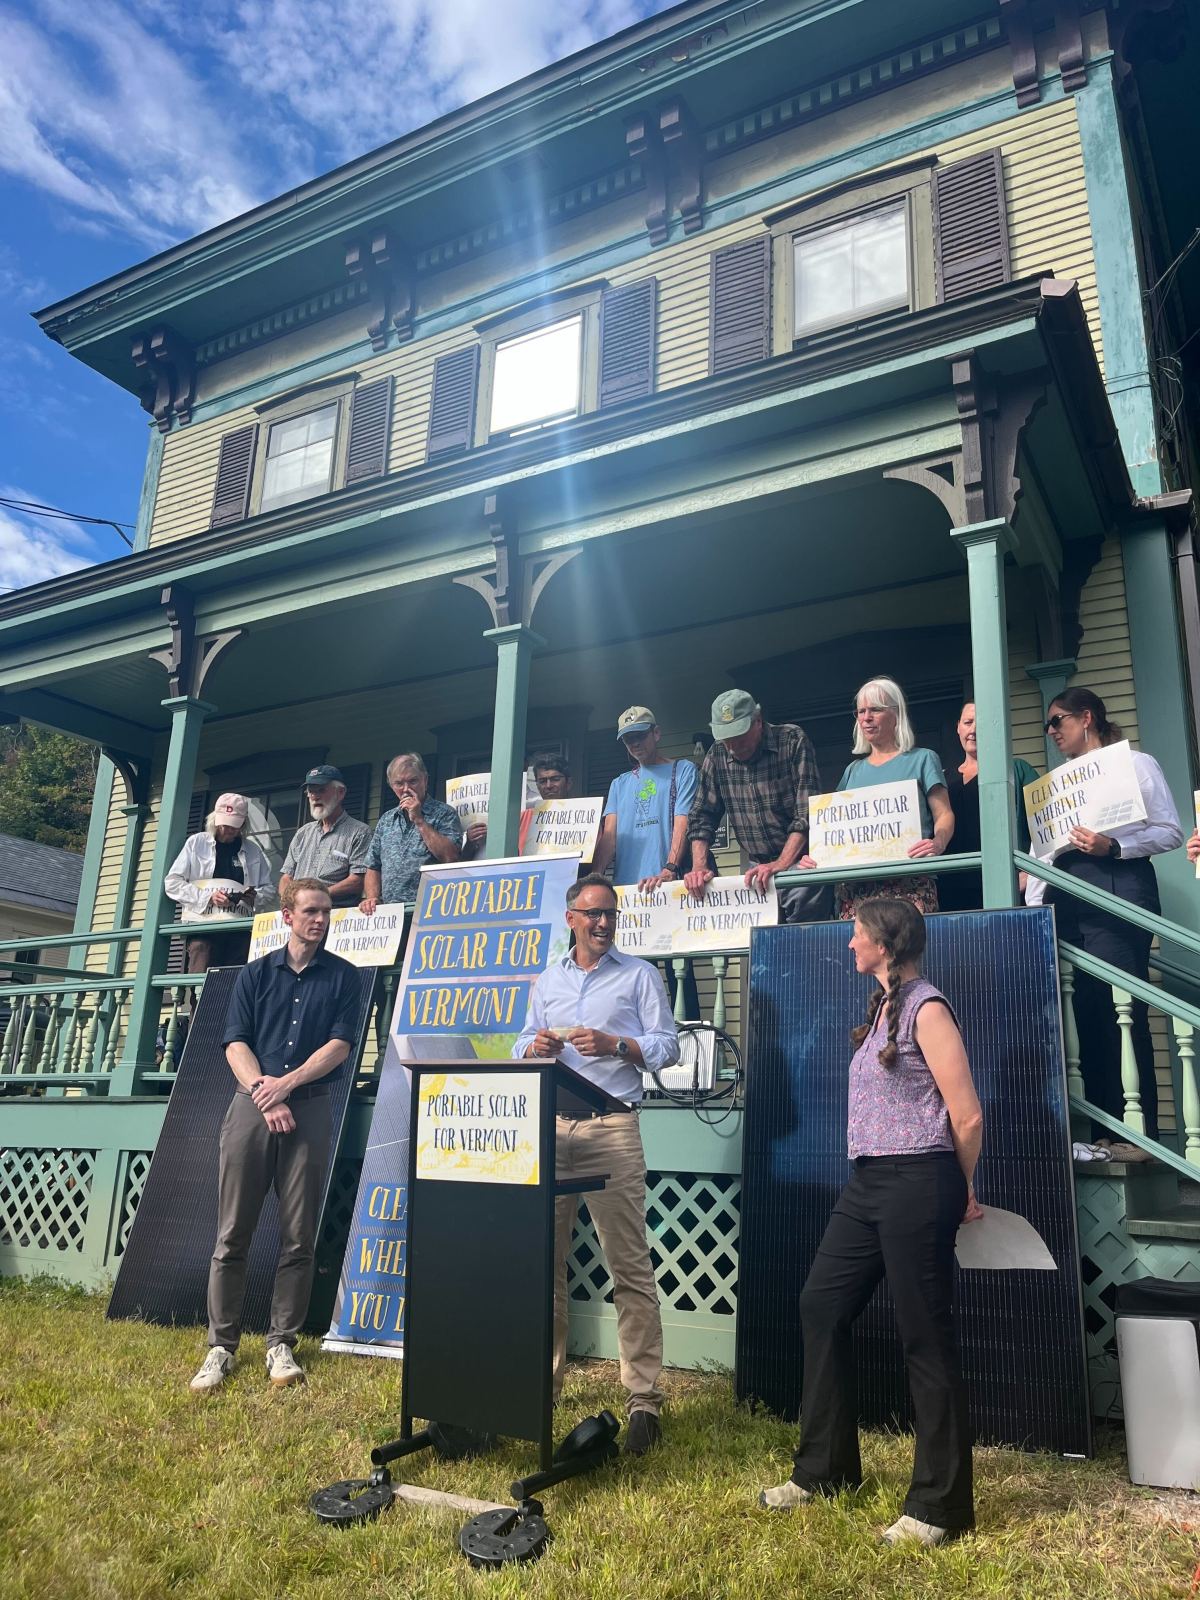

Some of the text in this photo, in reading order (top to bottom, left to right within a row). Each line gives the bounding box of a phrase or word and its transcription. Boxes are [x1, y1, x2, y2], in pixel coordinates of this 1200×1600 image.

[451, 782, 489, 802] PORTABLE
[1031, 777, 1059, 805] CLEAN
[226, 805, 234, 813] D
[471, 800, 489, 814] VER
[536, 809, 596, 826] PORTABLE SOLAR
[816, 794, 910, 825] PORTABLE SOLAR
[1033, 789, 1088, 827] WHEREVER
[536, 830, 588, 846] FOR VERMONT
[824, 820, 902, 847] FOR VERMONT
[1037, 821, 1055, 845] YOU
[424, 874, 540, 919] PORTABLE
[734, 888, 768, 907] SOLAR
[333, 914, 397, 934] PORTABLE SOLAR
[687, 912, 761, 931] FOR VERMONT
[334, 936, 389, 952] FOR VERMONT
[415, 926, 541, 974] SOLAR FOR
[408, 986, 521, 1027] VERMONT
[426, 1093, 528, 1119] PORTABLE SOLAR
[434, 1127, 519, 1153] FOR VERMONT
[359, 1237, 407, 1278] WHE
[349, 1291, 391, 1331] YOU
